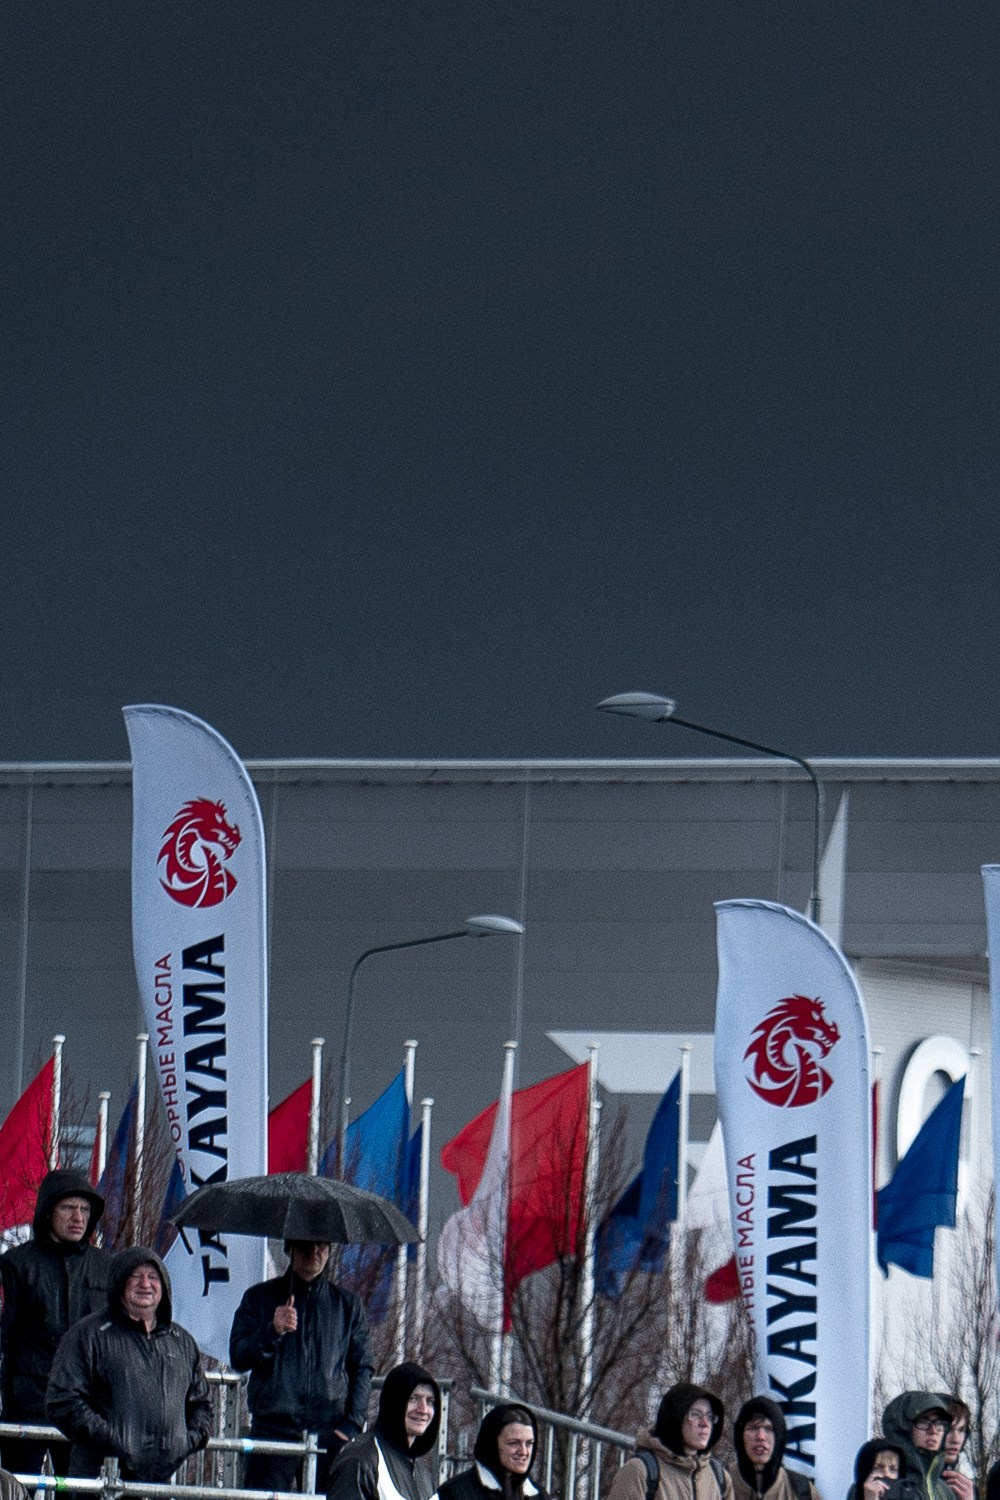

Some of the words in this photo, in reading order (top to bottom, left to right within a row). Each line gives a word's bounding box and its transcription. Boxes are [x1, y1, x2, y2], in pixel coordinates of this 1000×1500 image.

[154, 952, 174, 1048] МАСЛА
[737, 1153, 756, 1248] МАСЛА
[766, 1134, 817, 1484] AKAYAMA
